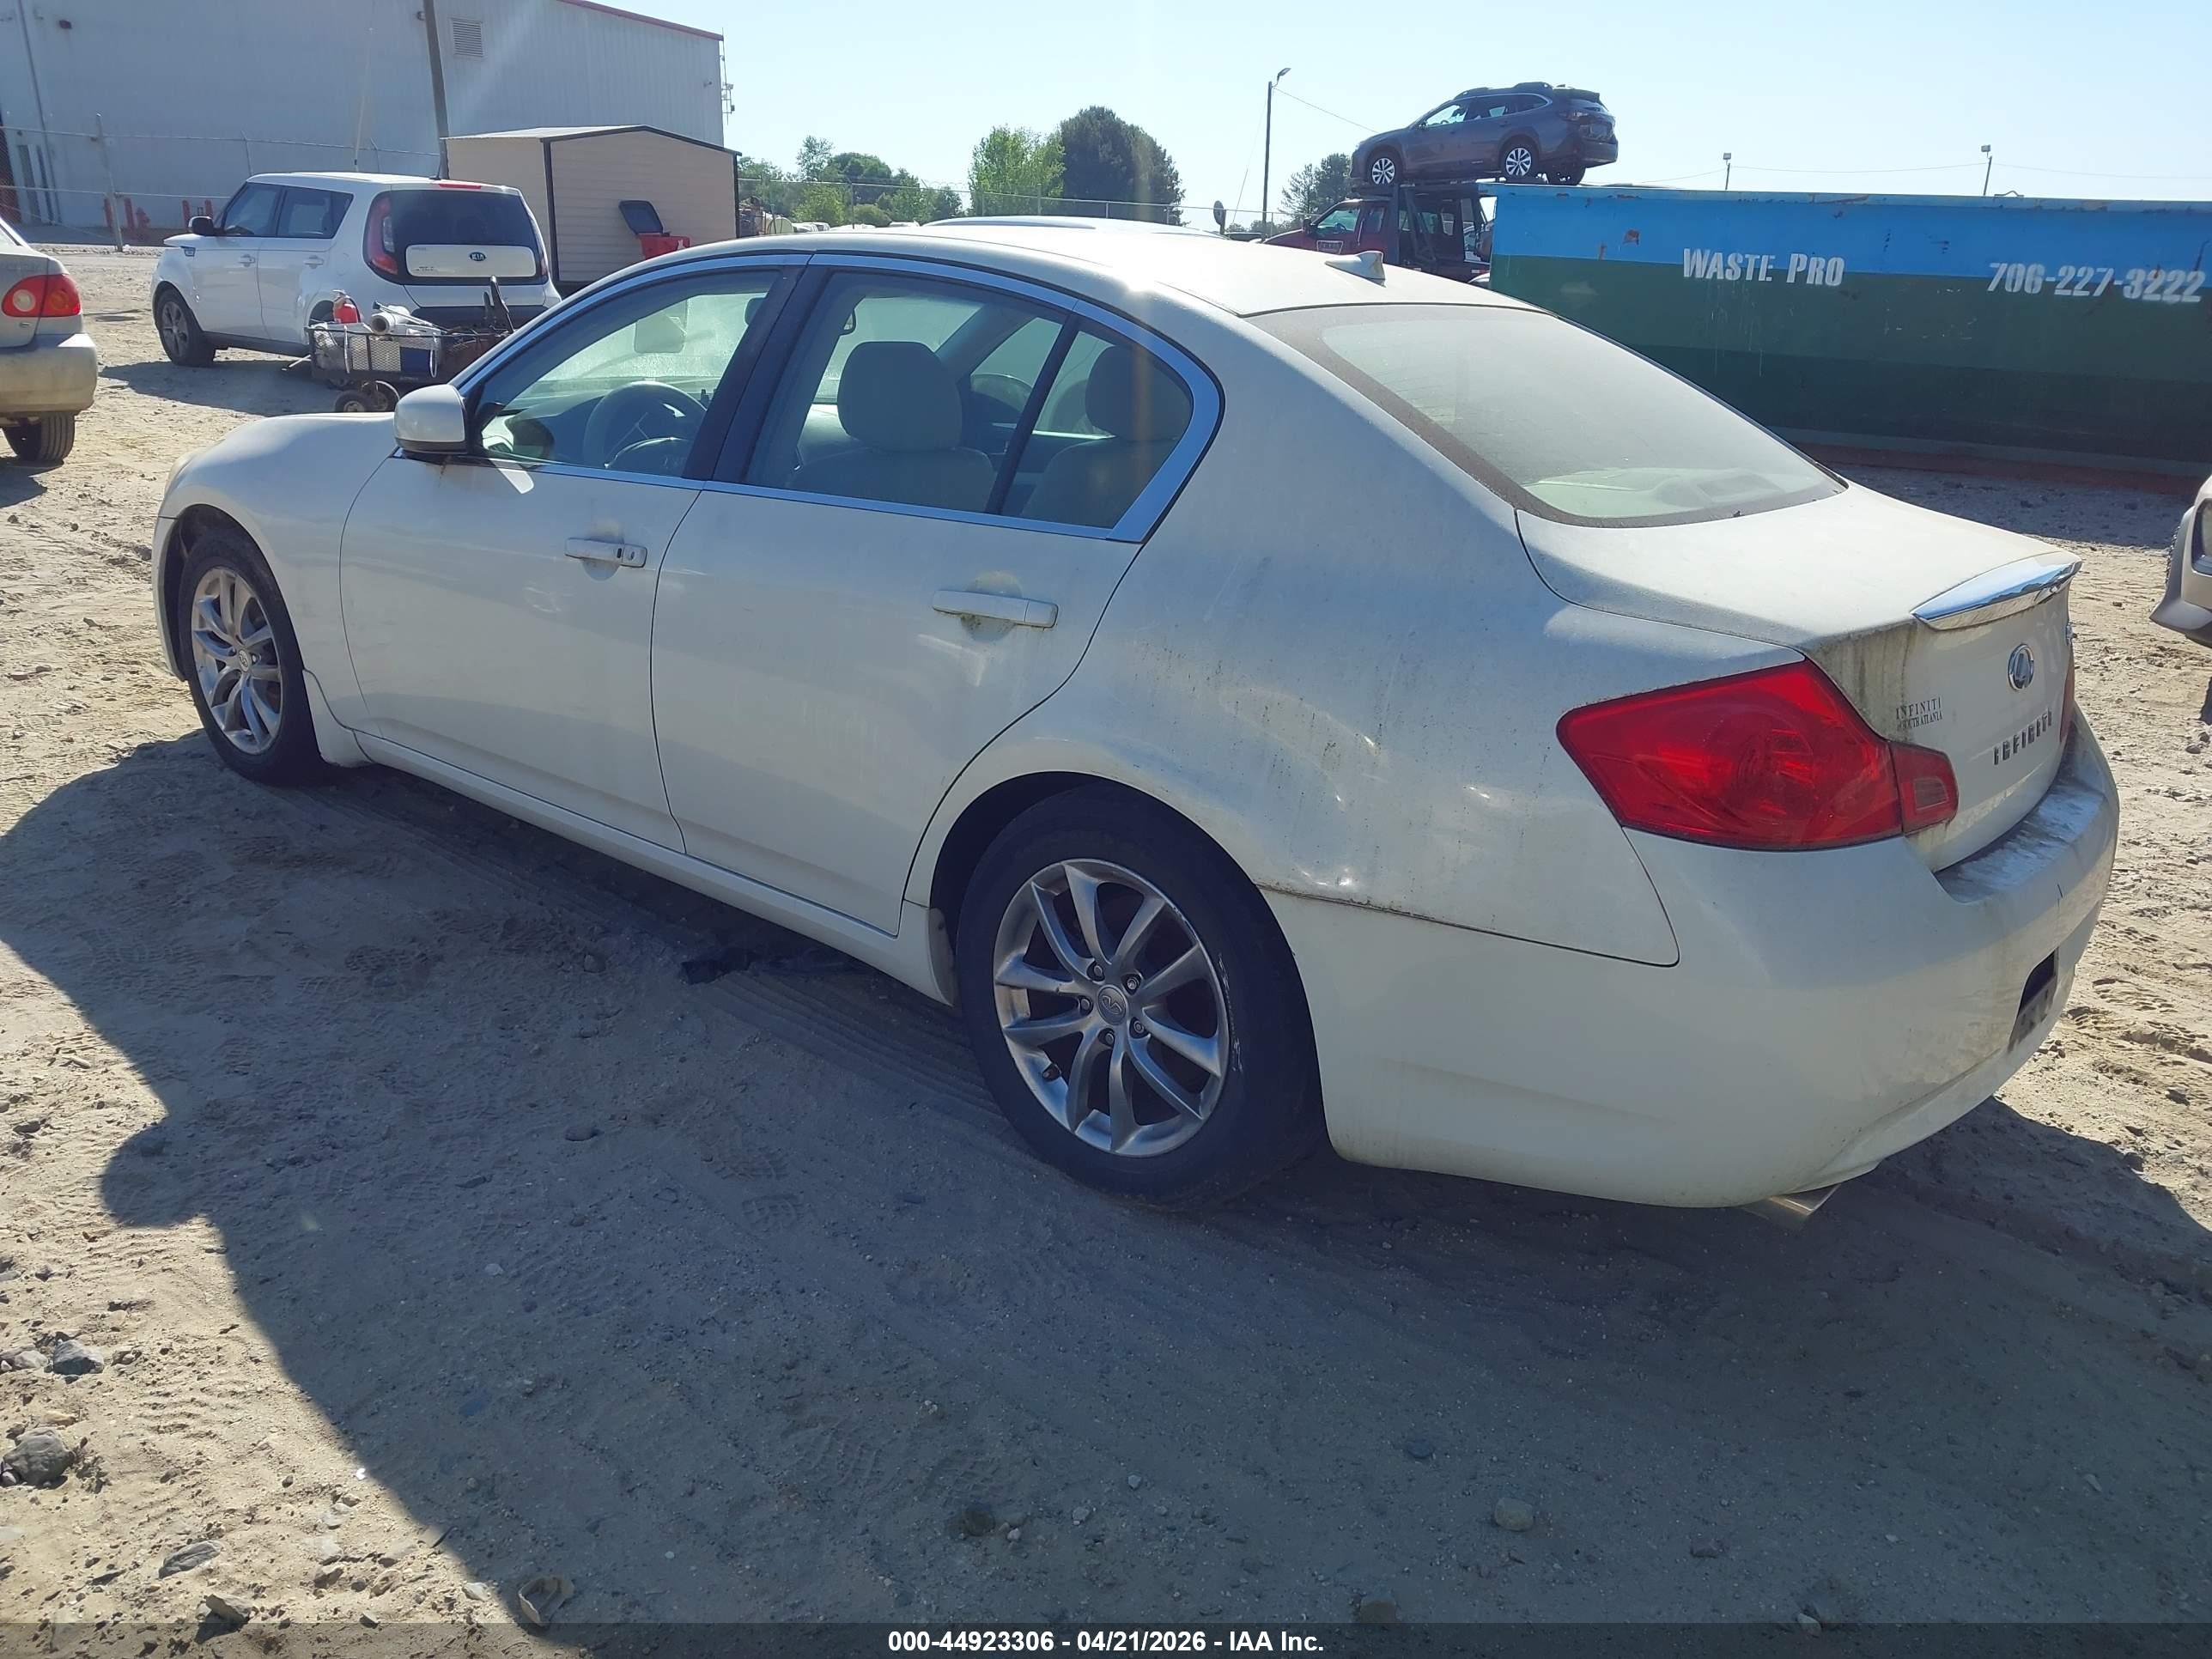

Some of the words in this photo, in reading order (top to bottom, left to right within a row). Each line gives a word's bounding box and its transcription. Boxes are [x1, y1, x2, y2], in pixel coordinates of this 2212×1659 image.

[1683, 247, 1776, 282] WASTE
[1786, 253, 1845, 286] PRO
[1986, 262, 2206, 302] 706-227-3222
[1896, 696, 1941, 720] INFINITI
[1994, 707, 2052, 766] INFINITI
